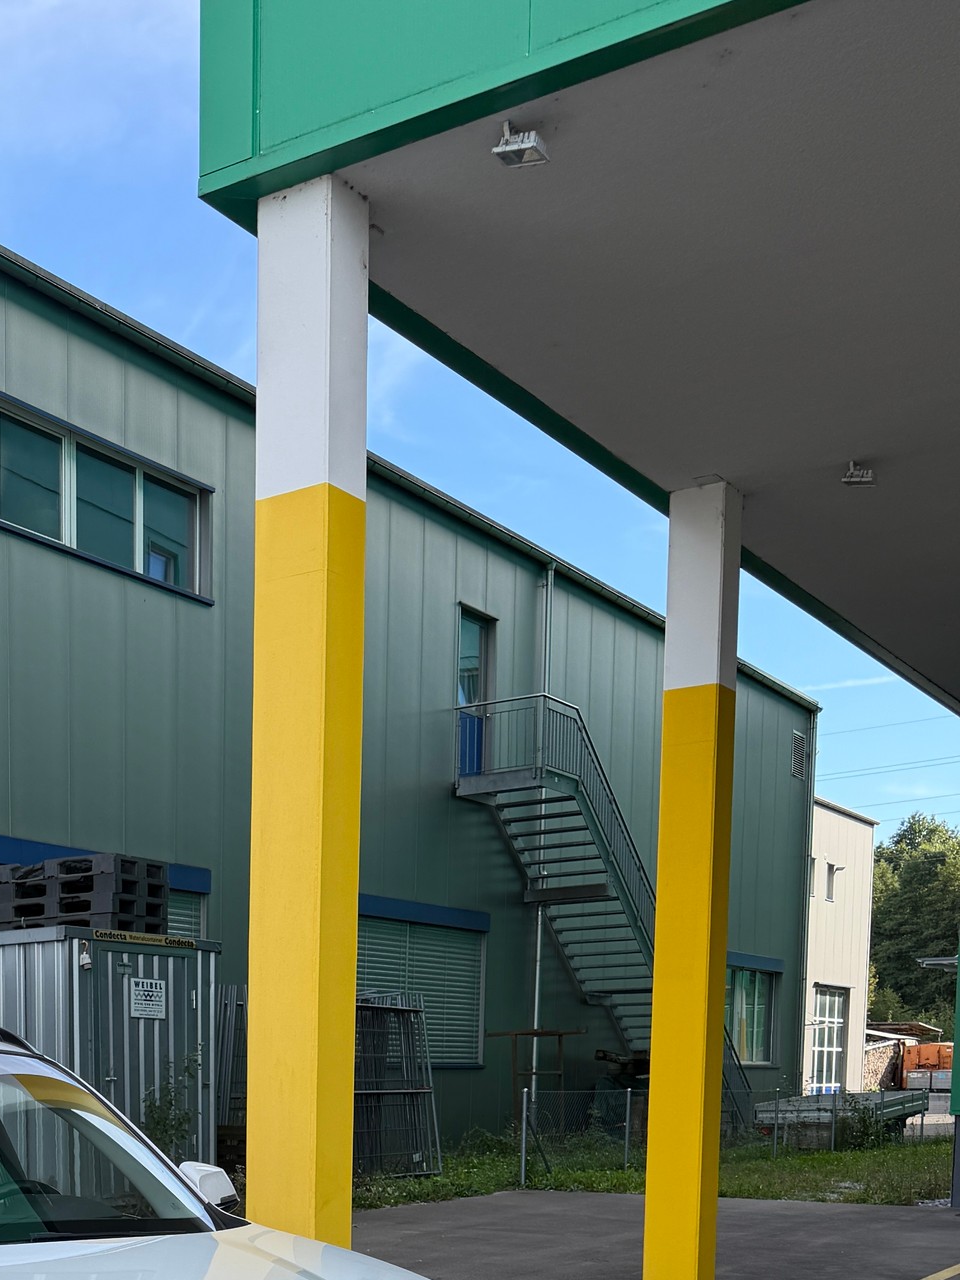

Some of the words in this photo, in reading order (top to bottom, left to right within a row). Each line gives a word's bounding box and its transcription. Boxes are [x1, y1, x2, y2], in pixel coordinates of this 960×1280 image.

[94, 930, 127, 941] Condecta
[164, 937, 194, 948] Condecta
[134, 980, 163, 990] WEIBEL
